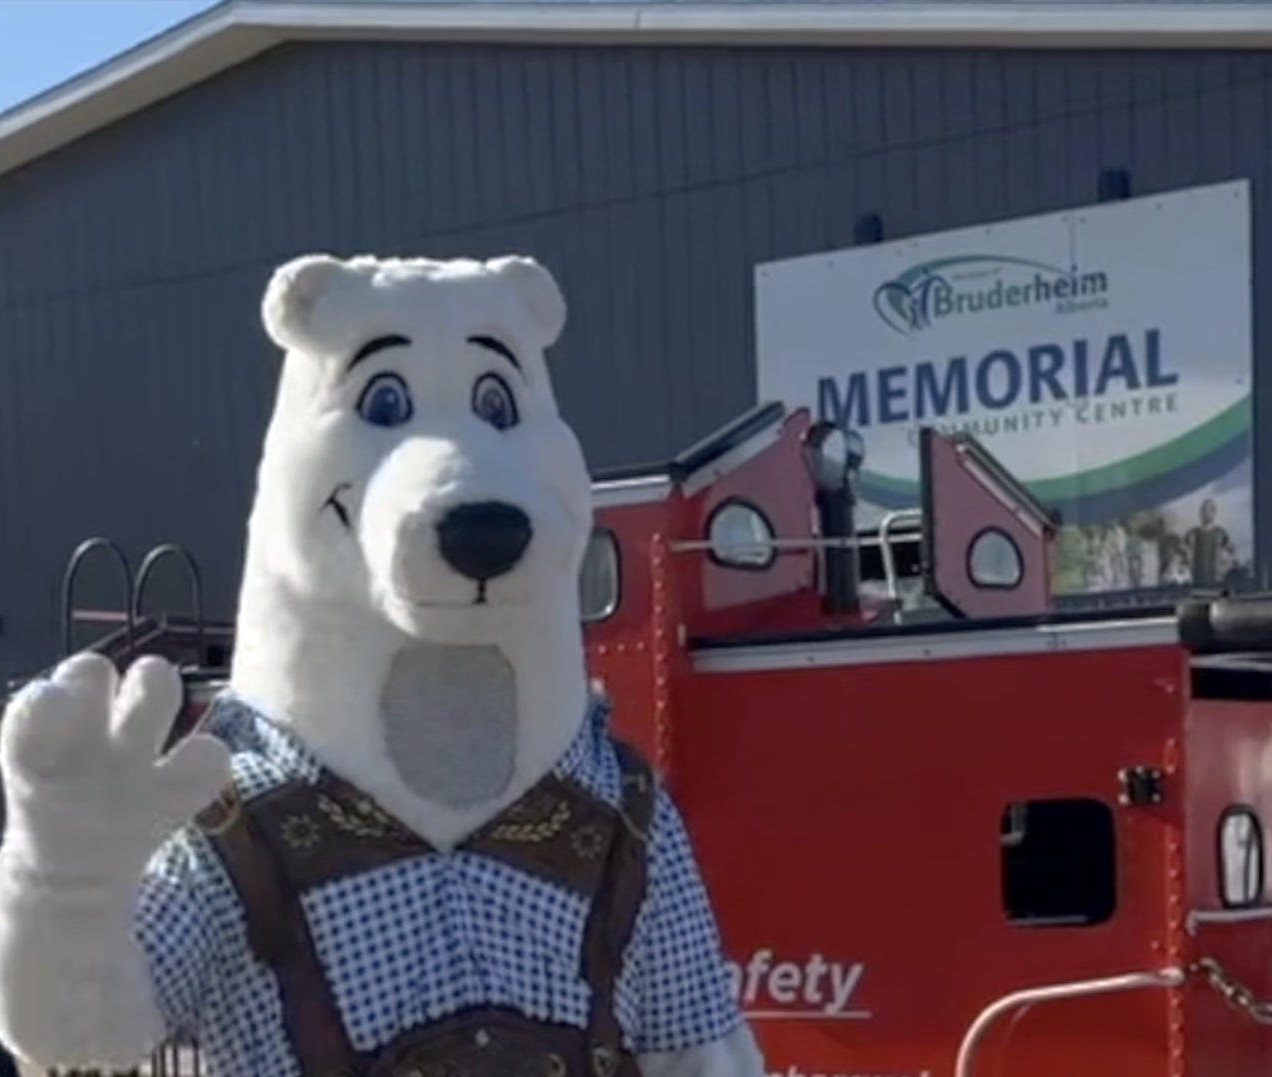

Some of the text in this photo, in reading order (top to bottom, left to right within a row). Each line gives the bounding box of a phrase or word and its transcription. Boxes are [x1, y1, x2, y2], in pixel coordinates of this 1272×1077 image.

[933, 264, 1108, 318] Bruderheim
[818, 328, 1180, 428] MEMORIAL
[1076, 393, 1179, 425] CENTRE
